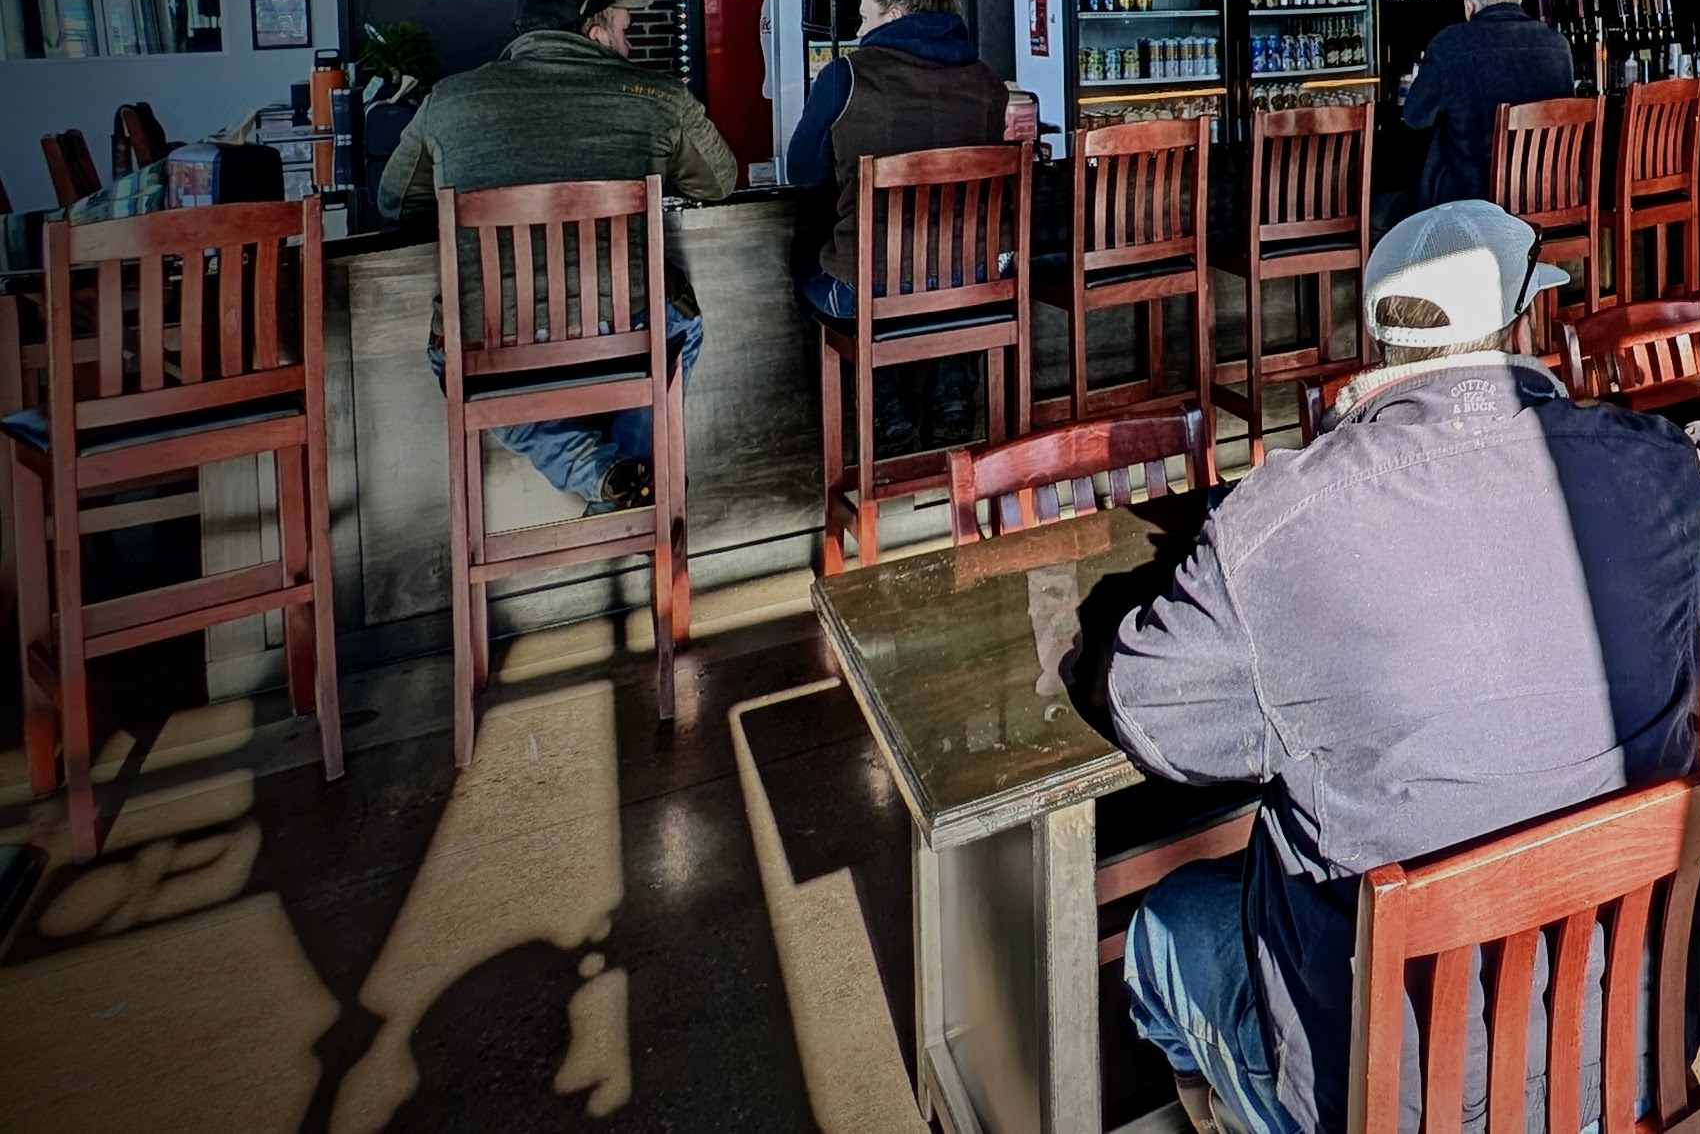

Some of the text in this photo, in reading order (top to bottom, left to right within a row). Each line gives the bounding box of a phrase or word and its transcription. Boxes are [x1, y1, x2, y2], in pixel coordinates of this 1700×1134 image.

[1451, 379, 1496, 397] CUTTER
[1453, 402, 1497, 414] & BUCK
